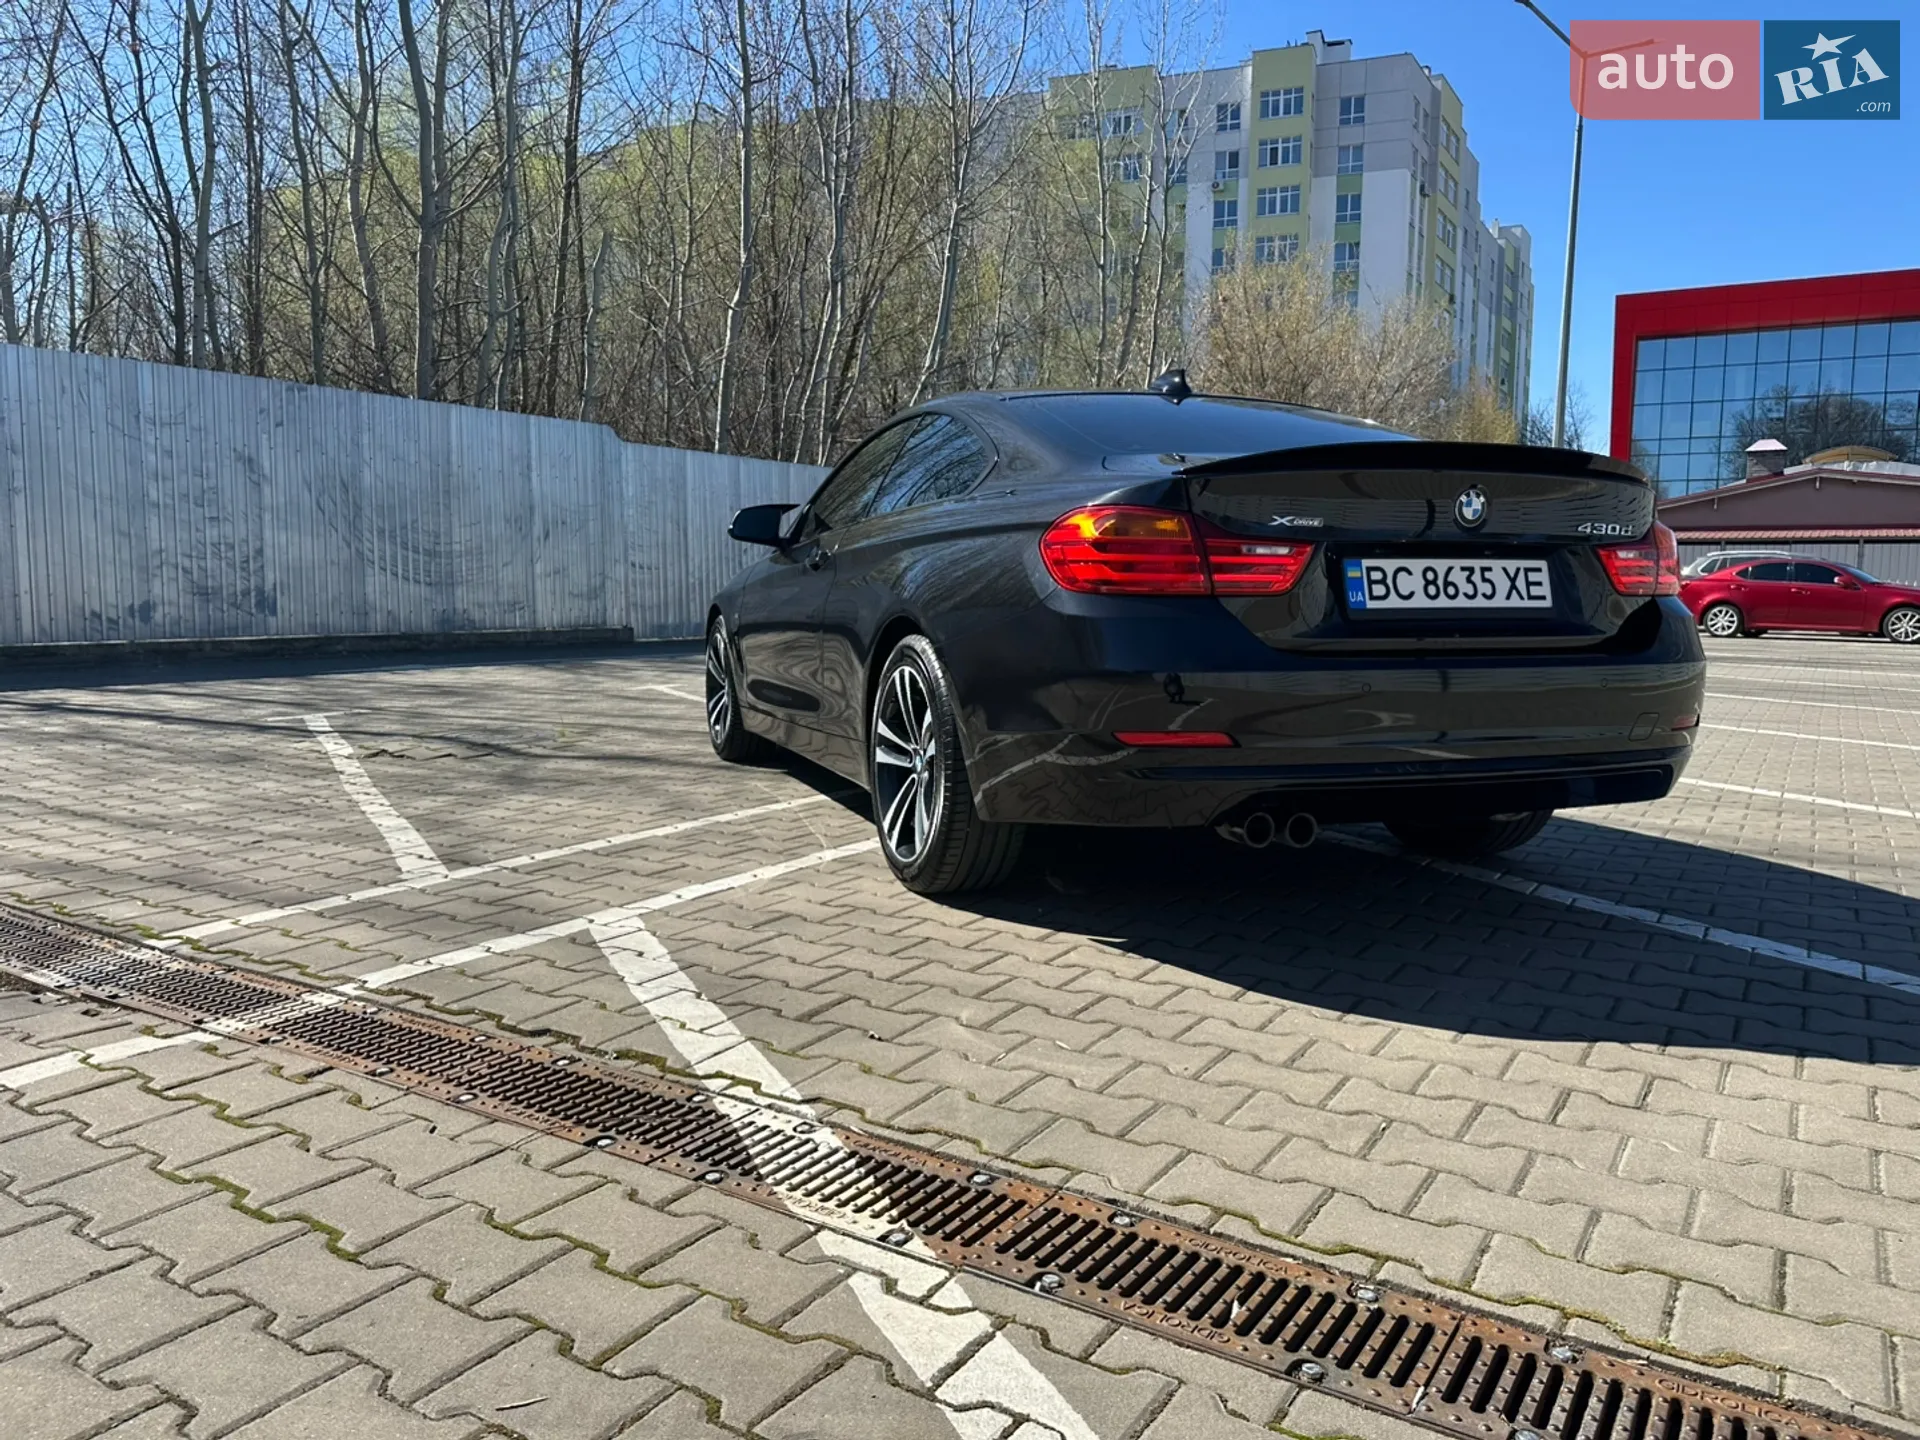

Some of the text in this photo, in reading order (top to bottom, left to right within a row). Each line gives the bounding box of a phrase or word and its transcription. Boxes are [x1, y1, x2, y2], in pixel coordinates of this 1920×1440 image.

[1577, 522, 1633, 536] 430d
[1349, 591, 1364, 602] UA
[1365, 566, 1547, 601] BC 8635 XE
[1187, 1238, 1288, 1275] GIDROLICA
[1655, 1378, 1801, 1430] GIDROLICA
